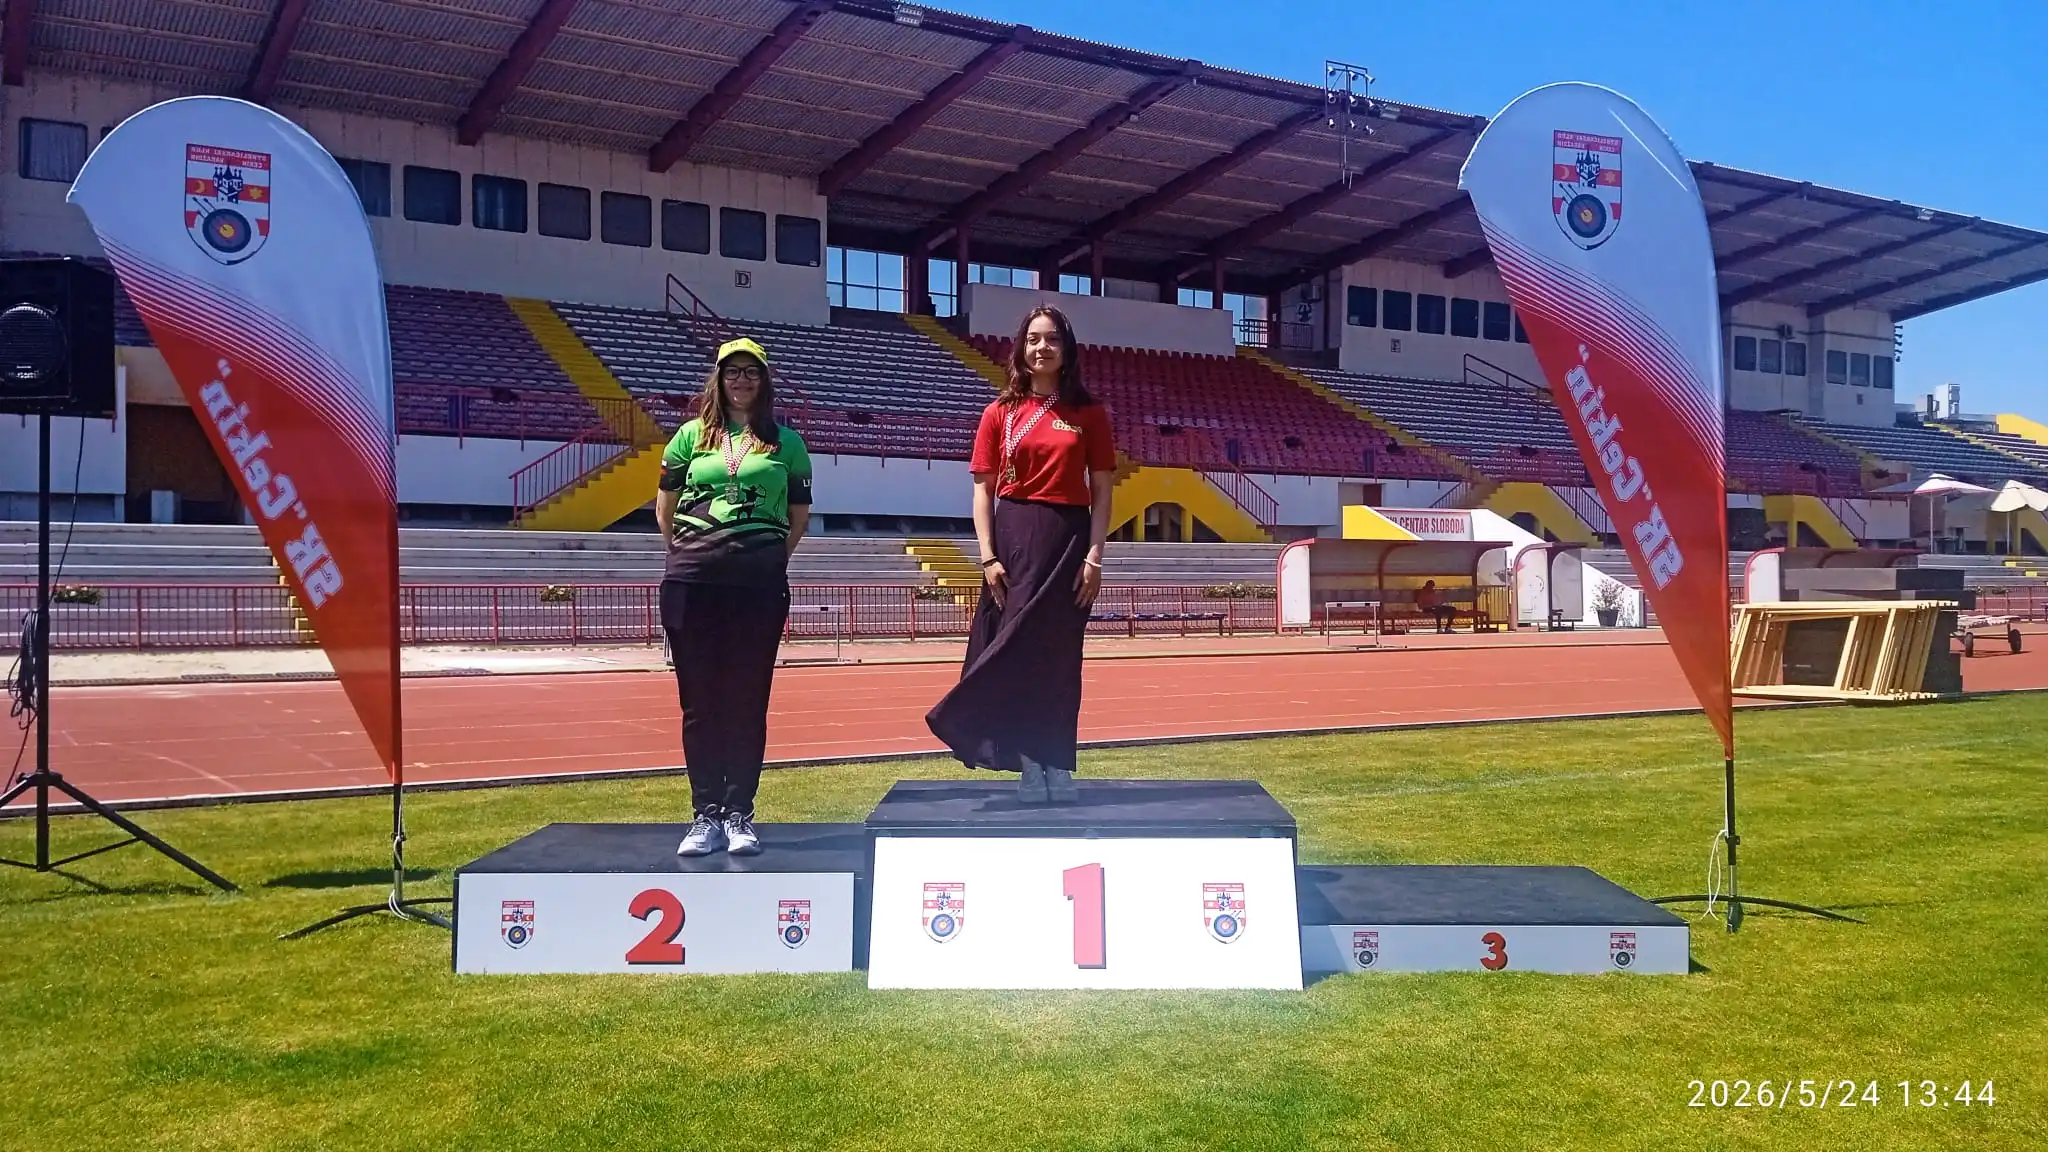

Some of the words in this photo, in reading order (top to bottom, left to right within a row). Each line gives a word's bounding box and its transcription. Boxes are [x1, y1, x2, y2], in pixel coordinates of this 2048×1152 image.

[1400, 516, 1429, 533] CENTAR
[1431, 517, 1465, 534] SLOBODA
[625, 888, 686, 965] 2
[1063, 863, 1107, 969] 1
[1480, 931, 1509, 971] 3
